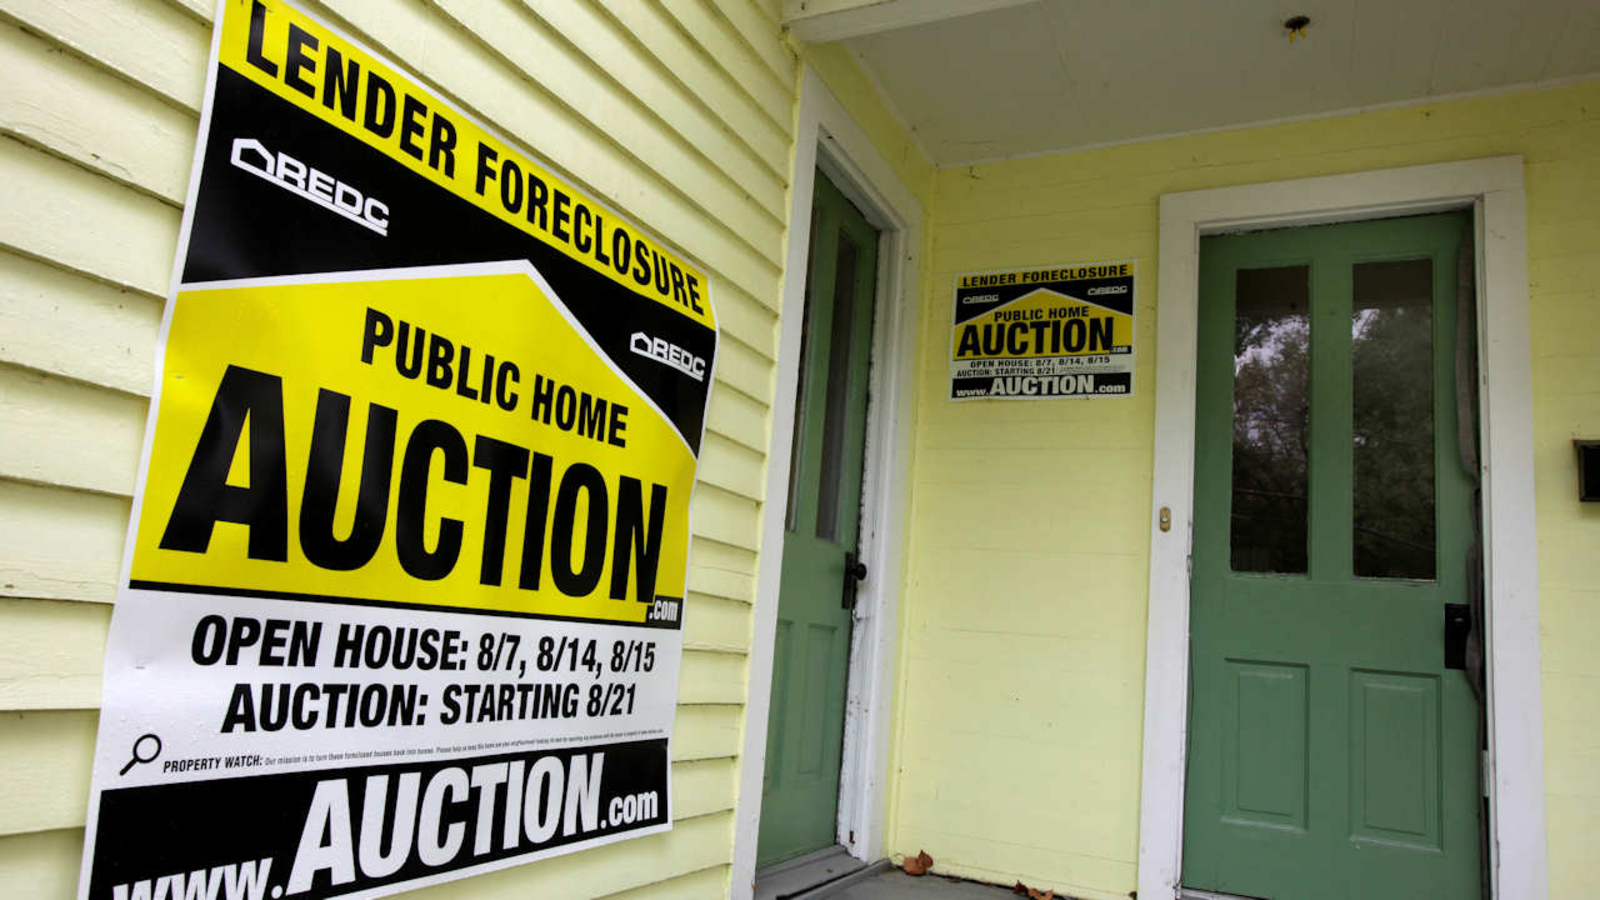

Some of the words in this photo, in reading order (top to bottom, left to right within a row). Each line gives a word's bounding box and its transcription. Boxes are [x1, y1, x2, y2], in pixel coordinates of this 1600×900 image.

[246, 0, 457, 180] LENDER
[475, 140, 704, 317] FORECLOSURE
[276, 151, 390, 230] REDC
[963, 273, 1016, 287] LENDER
[1022, 264, 1128, 283] FORECLOSURE
[994, 309, 1043, 322] PUBLIC
[1048, 306, 1090, 318] HOME
[653, 336, 705, 377] REDC
[956, 317, 1114, 357] AUCTION
[361, 306, 520, 412] PUBLIC
[531, 373, 629, 448] HOME
[994, 368, 1035, 376] STARTING
[1036, 367, 1056, 375] 8/21
[1087, 356, 1110, 364] 8/15
[158, 364, 668, 604] AUCTION
[190, 614, 322, 670] OPEN
[334, 623, 469, 672] HOUSE:
[477, 633, 526, 678] 8/7,
[536, 635, 604, 679] 8/14,
[610, 640, 656, 674] 8/15
[220, 682, 428, 734] AUCTION:
[439, 685, 579, 726] STARTING
[585, 683, 637, 718] 8/21
[163, 757, 221, 774] PROPERTY
[225, 755, 263, 770] WATCH:
